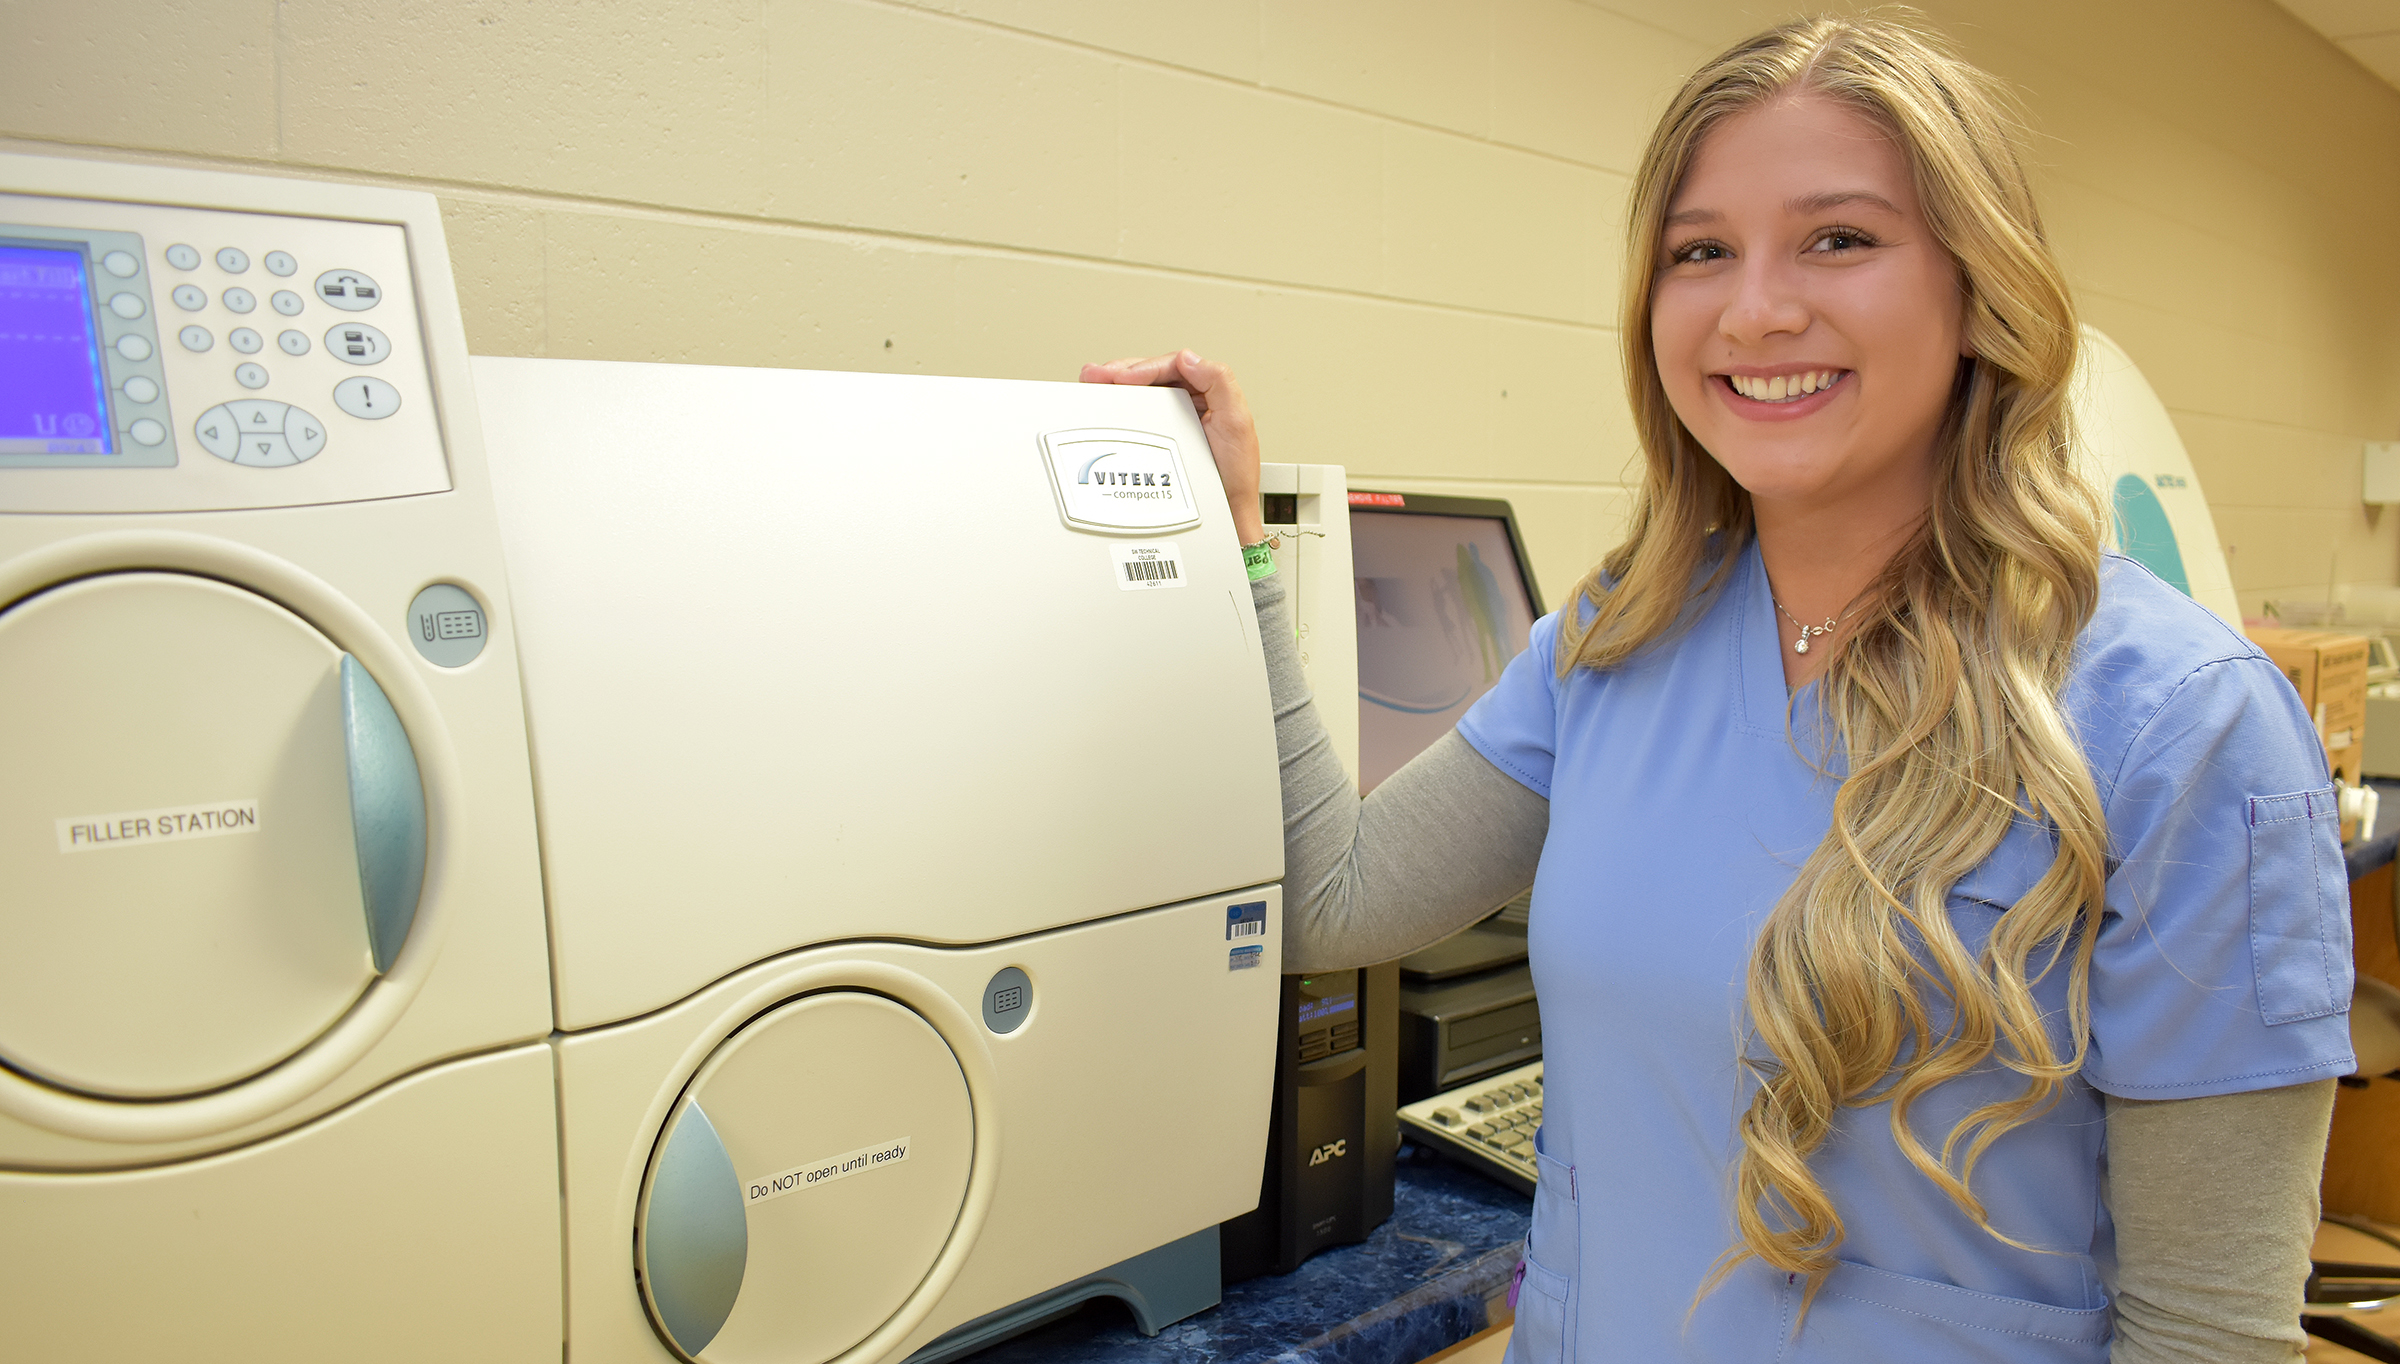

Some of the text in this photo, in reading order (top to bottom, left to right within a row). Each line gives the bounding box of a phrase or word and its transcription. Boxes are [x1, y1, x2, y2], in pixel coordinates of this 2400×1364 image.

[243, 336, 250, 346] 8
[291, 338, 298, 347] 9
[1094, 472, 1171, 487] VITEK 2
[1113, 490, 1160, 501] compact
[1247, 552, 1269, 567] Par
[71, 807, 255, 845] FILLER STATION
[1309, 1139, 1346, 1167] APC
[750, 1144, 907, 1200] Do NOT open until ready
